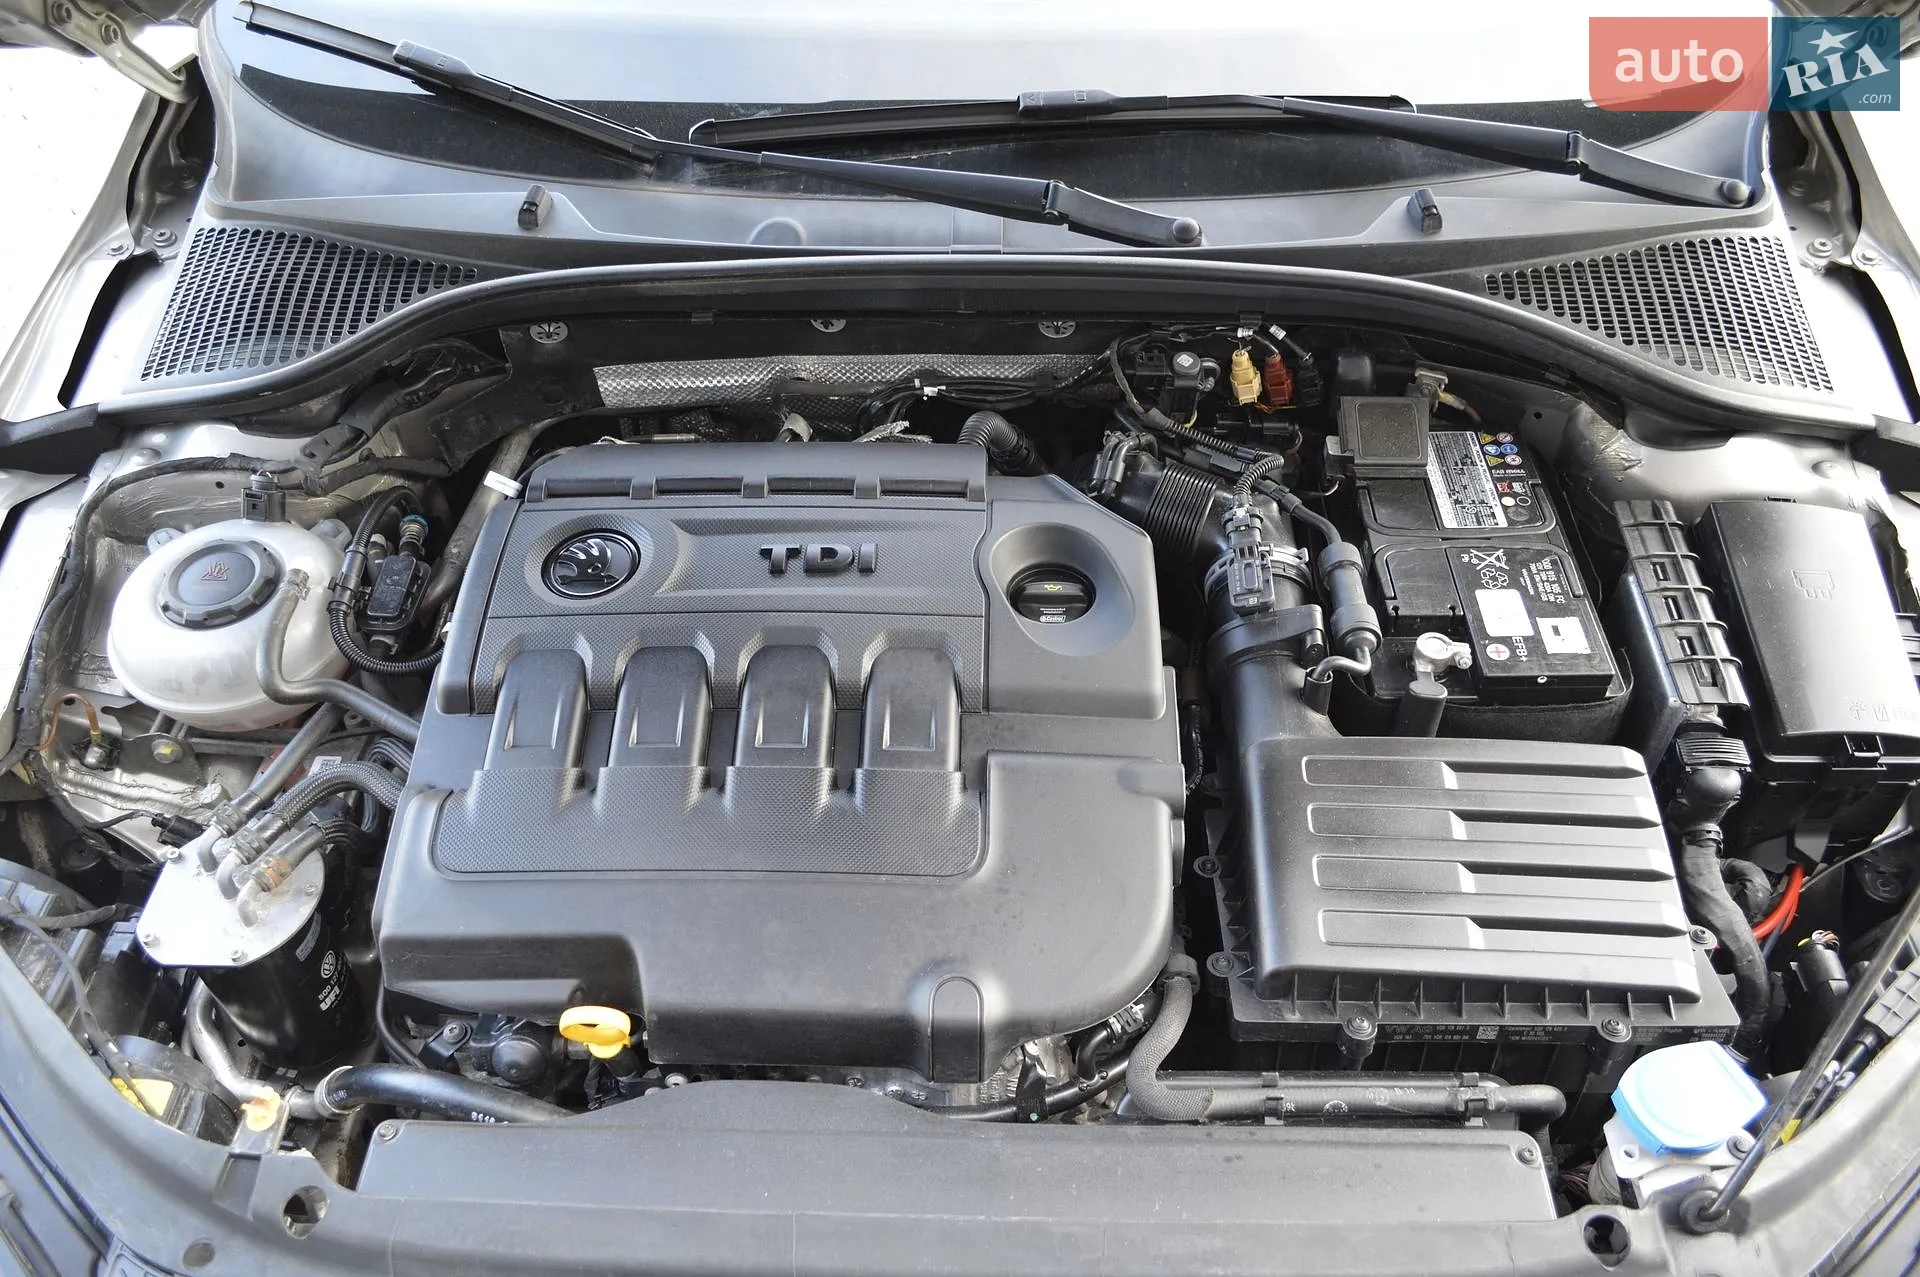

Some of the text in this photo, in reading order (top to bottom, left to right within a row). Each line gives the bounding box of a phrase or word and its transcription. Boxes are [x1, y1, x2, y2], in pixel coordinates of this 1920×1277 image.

[760, 543, 878, 574] TDI
[1460, 554, 1469, 562] Pb
[1511, 637, 1528, 662] EFB+
